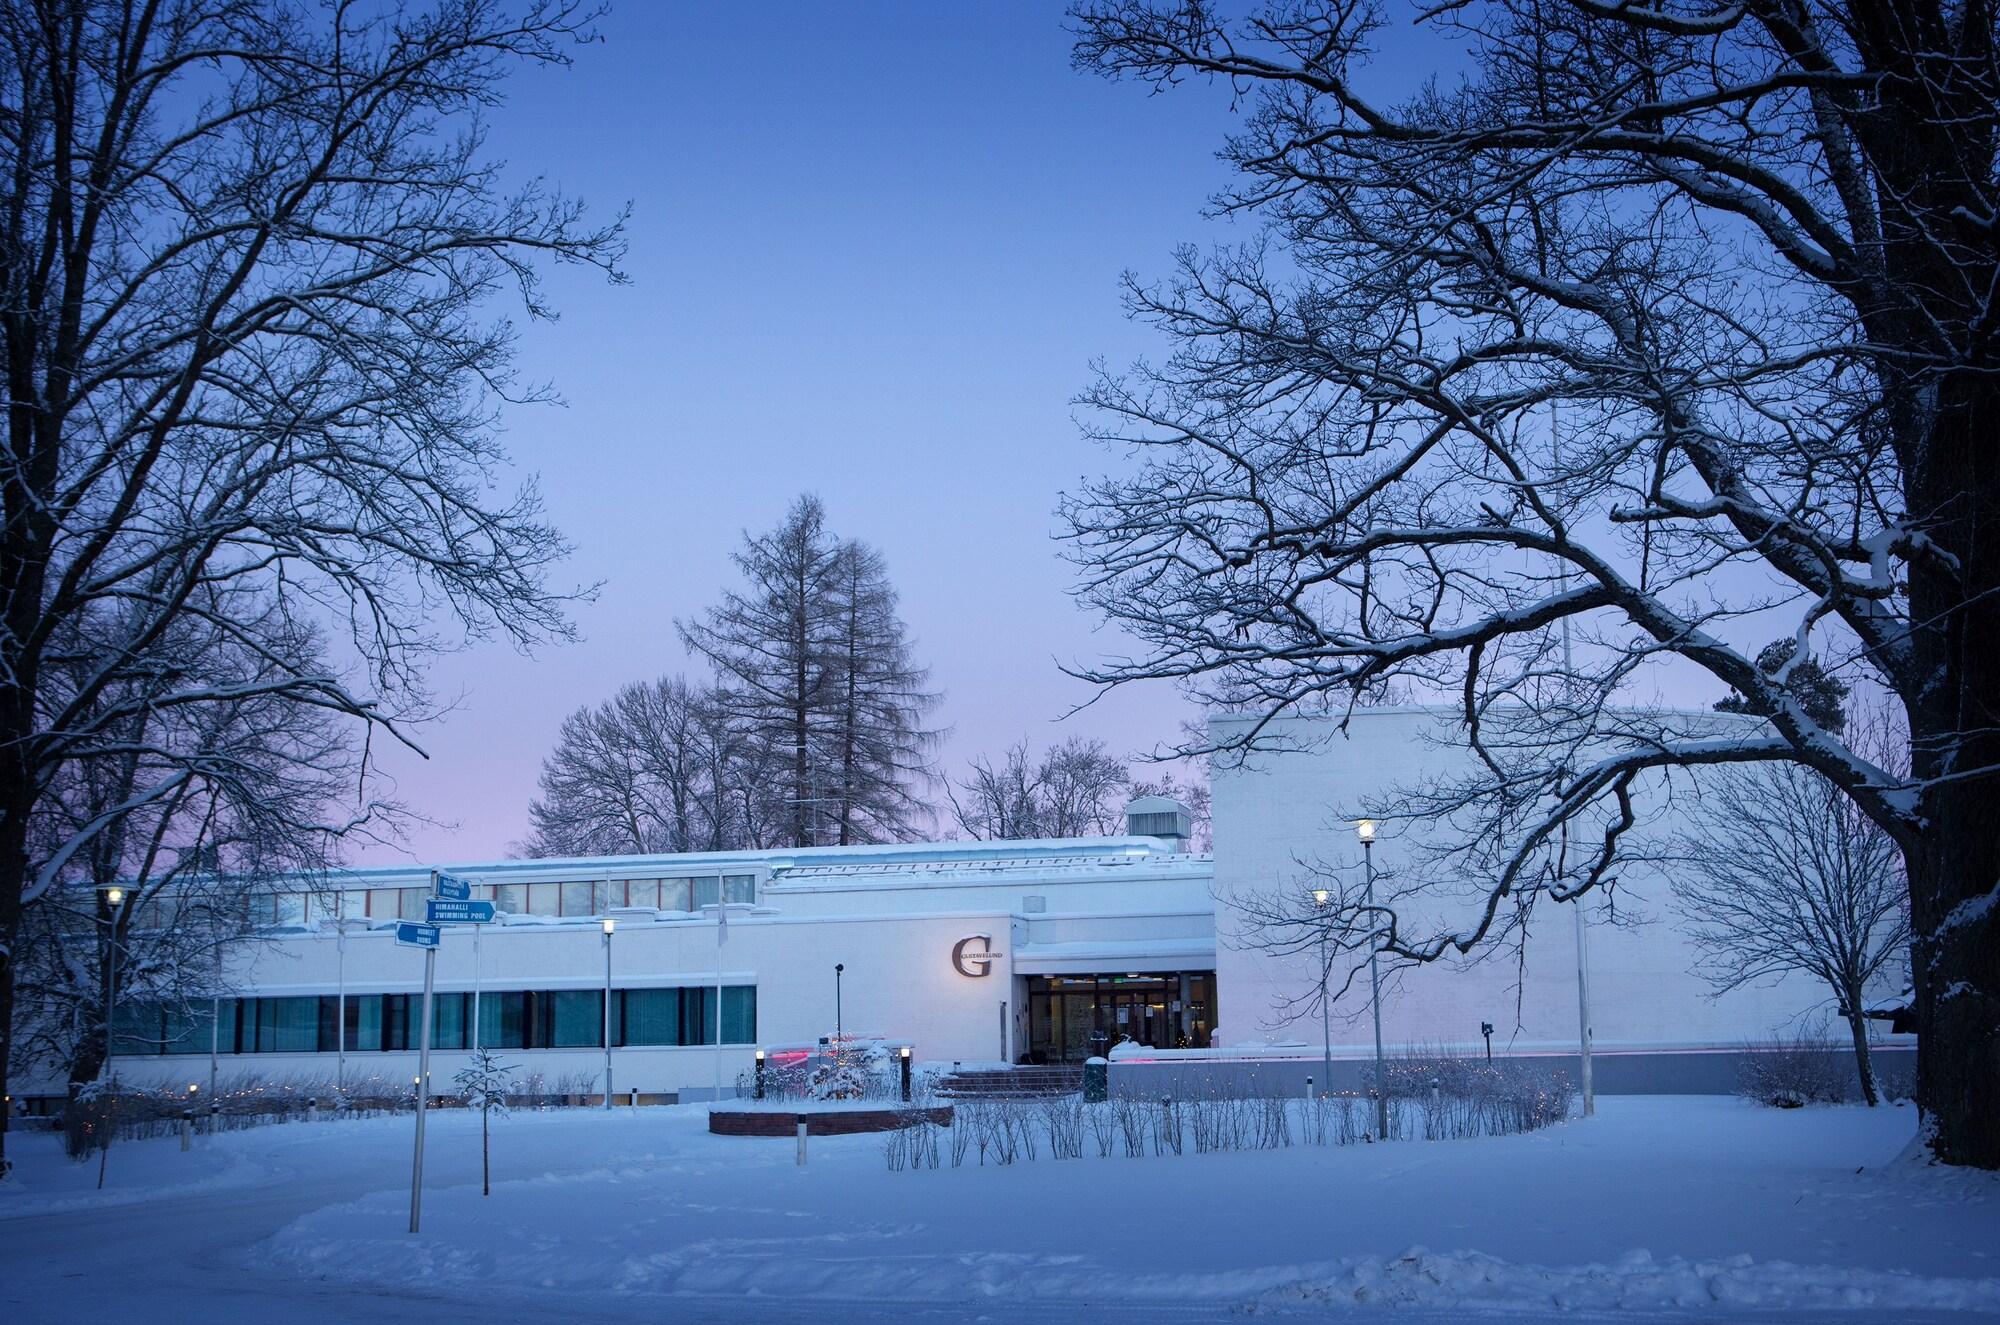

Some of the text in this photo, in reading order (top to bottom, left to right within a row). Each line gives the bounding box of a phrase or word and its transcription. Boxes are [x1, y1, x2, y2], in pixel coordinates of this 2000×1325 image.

[470, 912, 486, 920] POOL
[952, 935, 991, 977] G
[960, 952, 1003, 960] GUSTAVELUND
